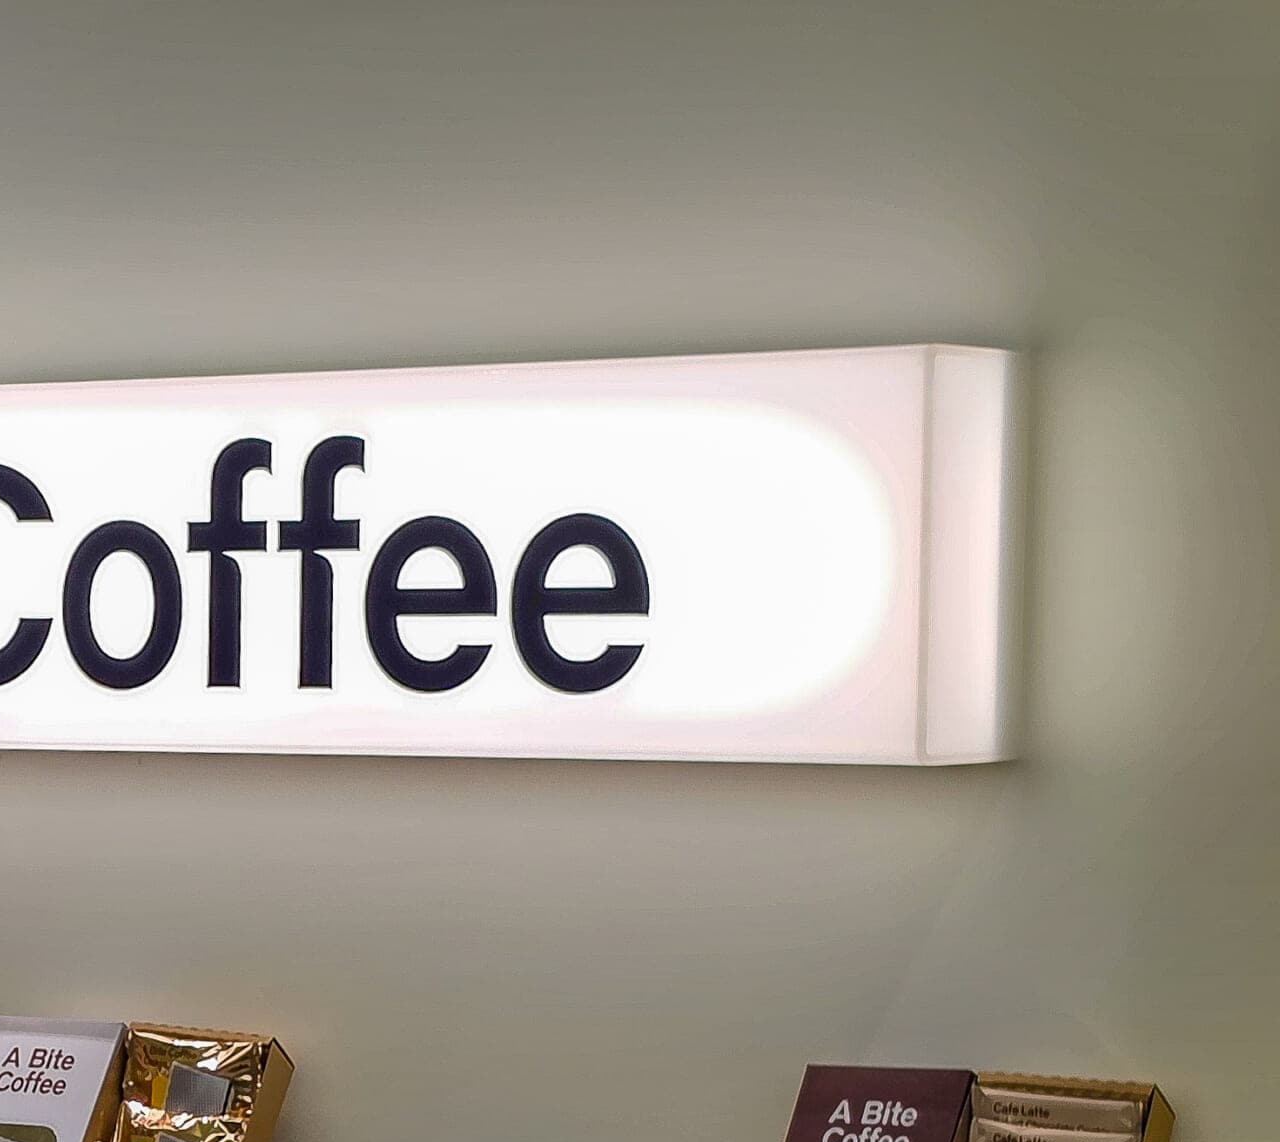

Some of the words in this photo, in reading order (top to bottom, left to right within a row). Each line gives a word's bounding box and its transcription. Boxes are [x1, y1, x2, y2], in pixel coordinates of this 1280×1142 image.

[2, 1047, 20, 1068] A
[28, 1049, 75, 1071] Bite
[828, 1099, 851, 1125] A
[861, 1100, 918, 1128] Bite
[993, 1102, 1019, 1115] Cafe
[1021, 1103, 1050, 1119] Latte
